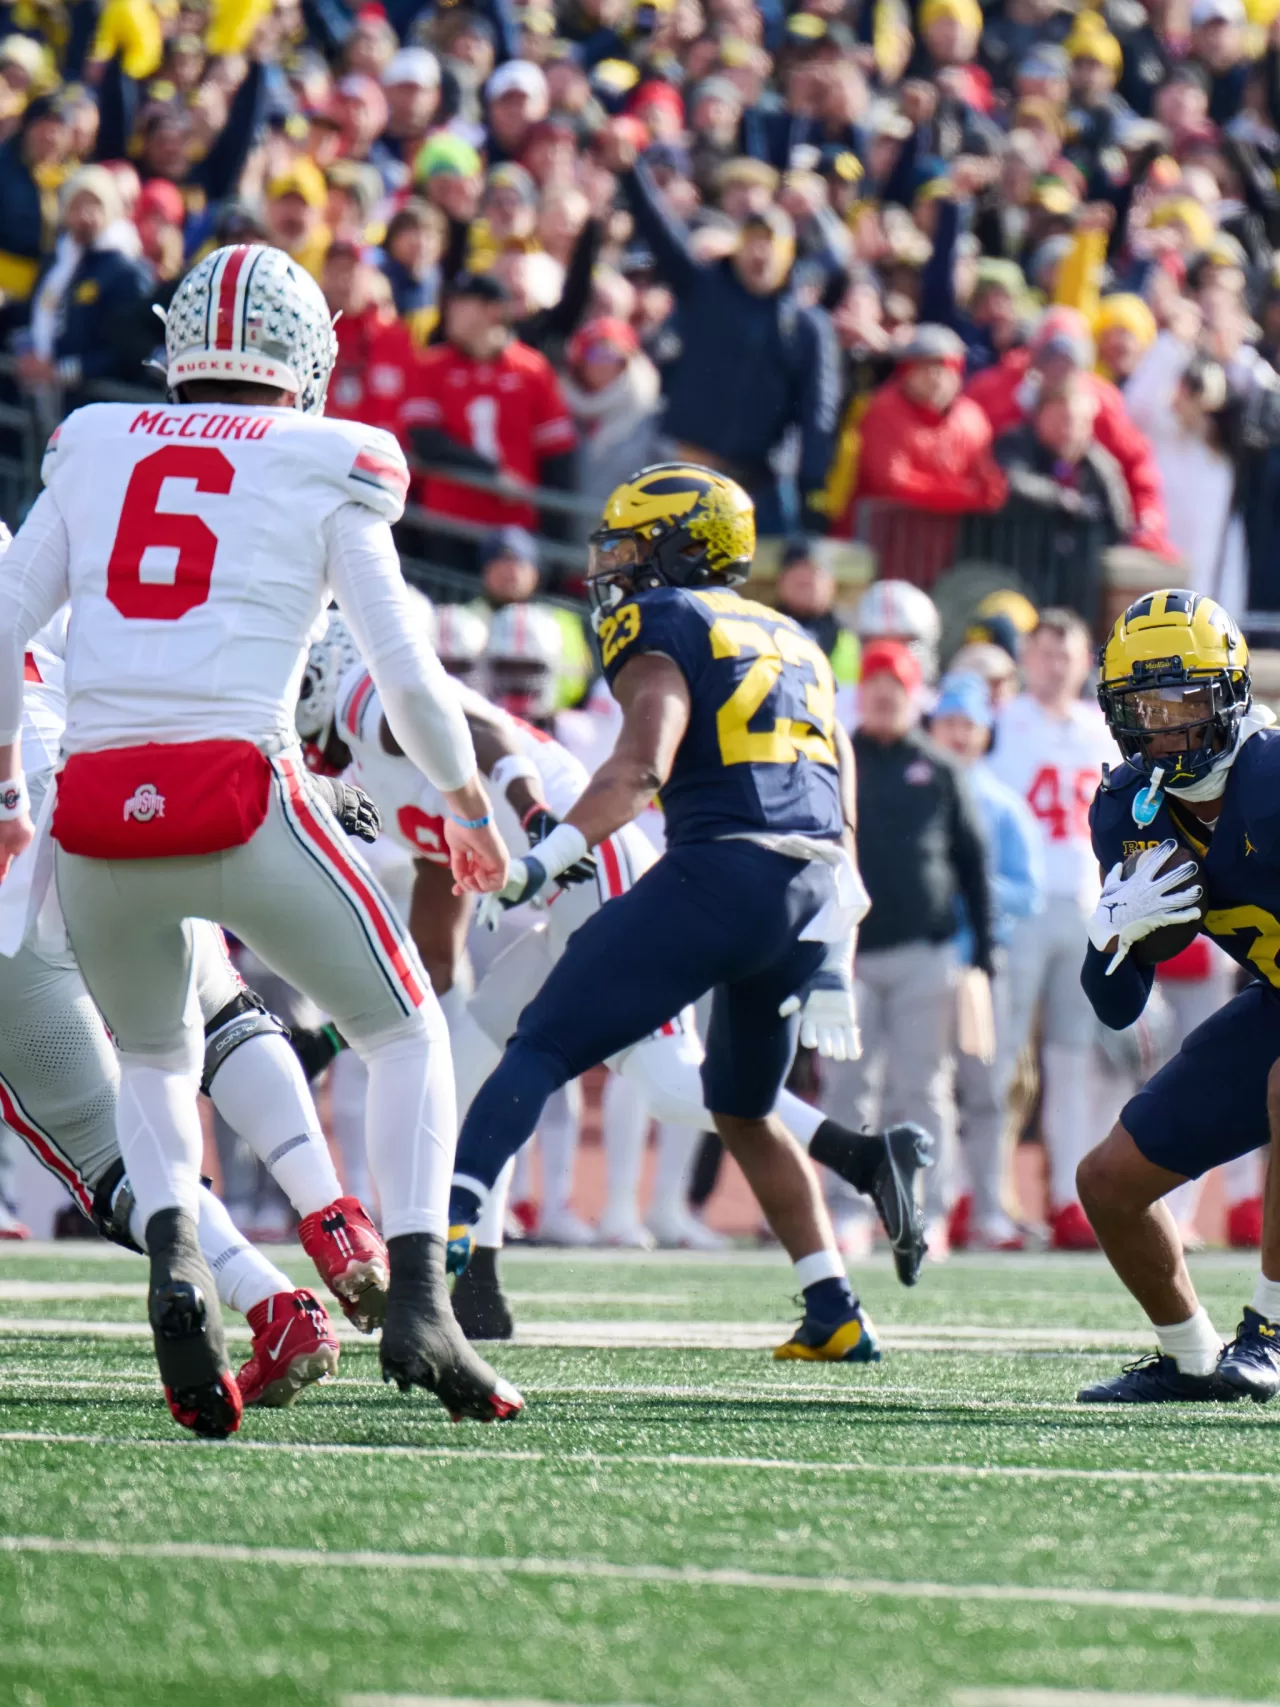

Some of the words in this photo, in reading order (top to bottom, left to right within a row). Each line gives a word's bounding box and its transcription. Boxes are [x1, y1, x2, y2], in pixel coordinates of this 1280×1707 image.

[106, 444, 236, 620] 6
[599, 603, 641, 667] 23
[709, 618, 838, 767] 23
